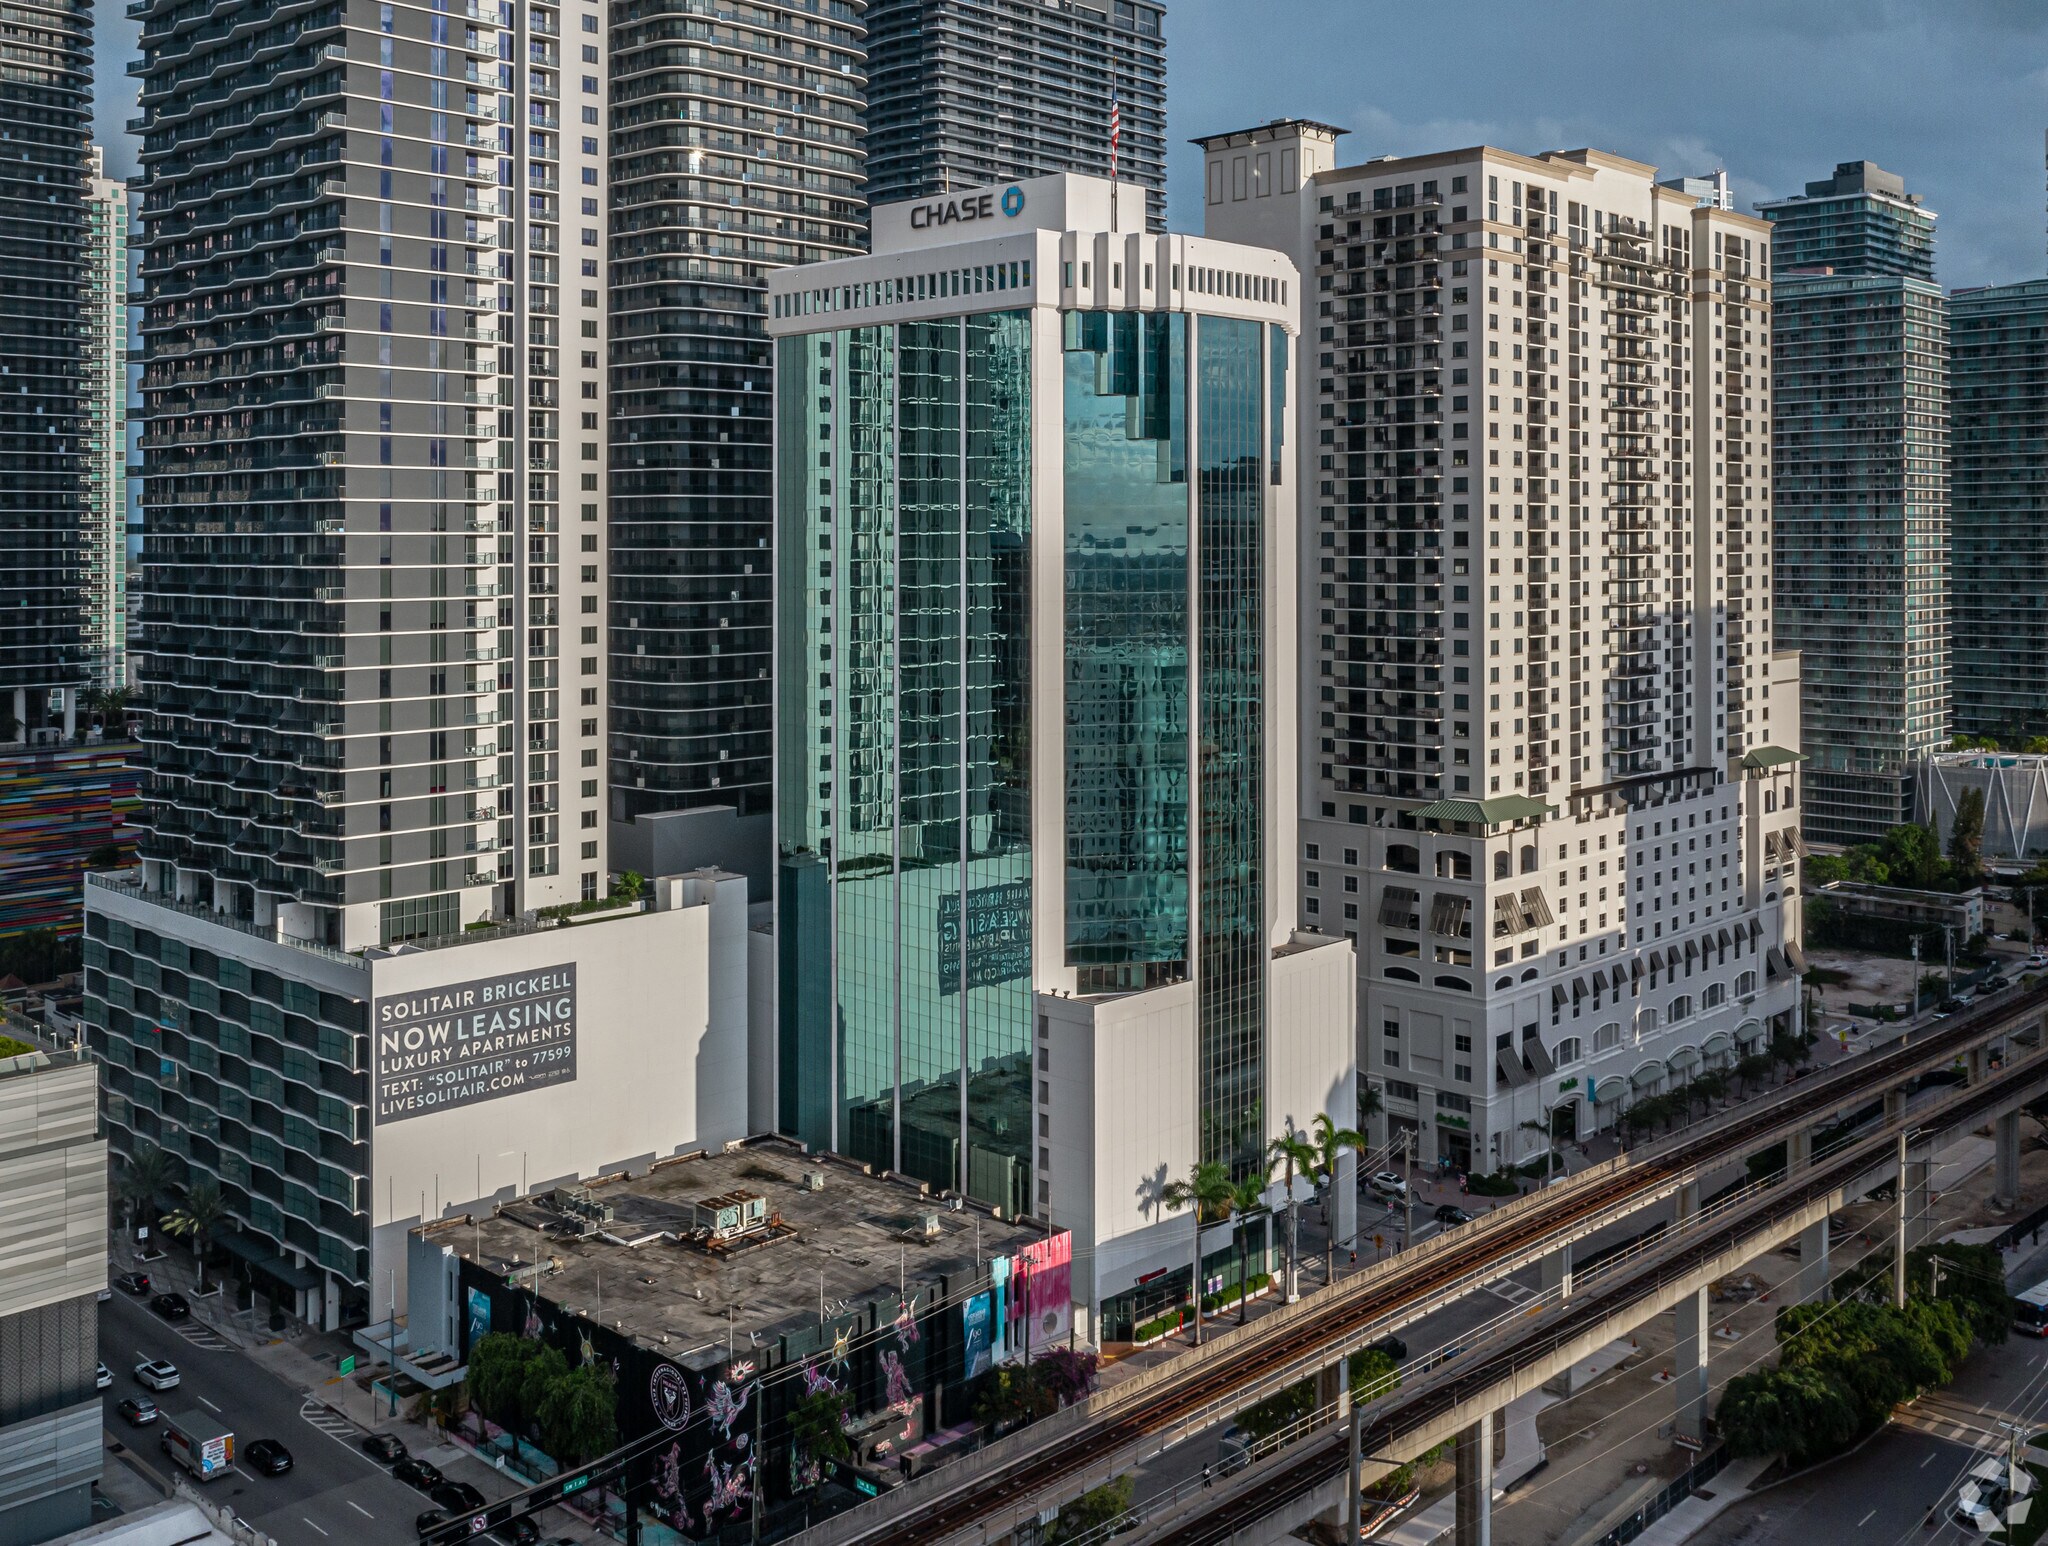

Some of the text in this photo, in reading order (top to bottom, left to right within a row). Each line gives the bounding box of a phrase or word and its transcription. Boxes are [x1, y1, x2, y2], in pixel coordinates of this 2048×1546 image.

[911, 194, 994, 229] CHASE
[382, 972, 571, 1022] SOLITAIR BRICKELL
[381, 998, 572, 1056] NOW LEASING
[381, 1022, 572, 1075] LUXURY APARTMENTS
[381, 1072, 525, 1116] LIVESOLITAIR.COM
[382, 1079, 423, 1098] TEXT:
[515, 1058, 528, 1069] to
[532, 1046, 571, 1065] 77599
